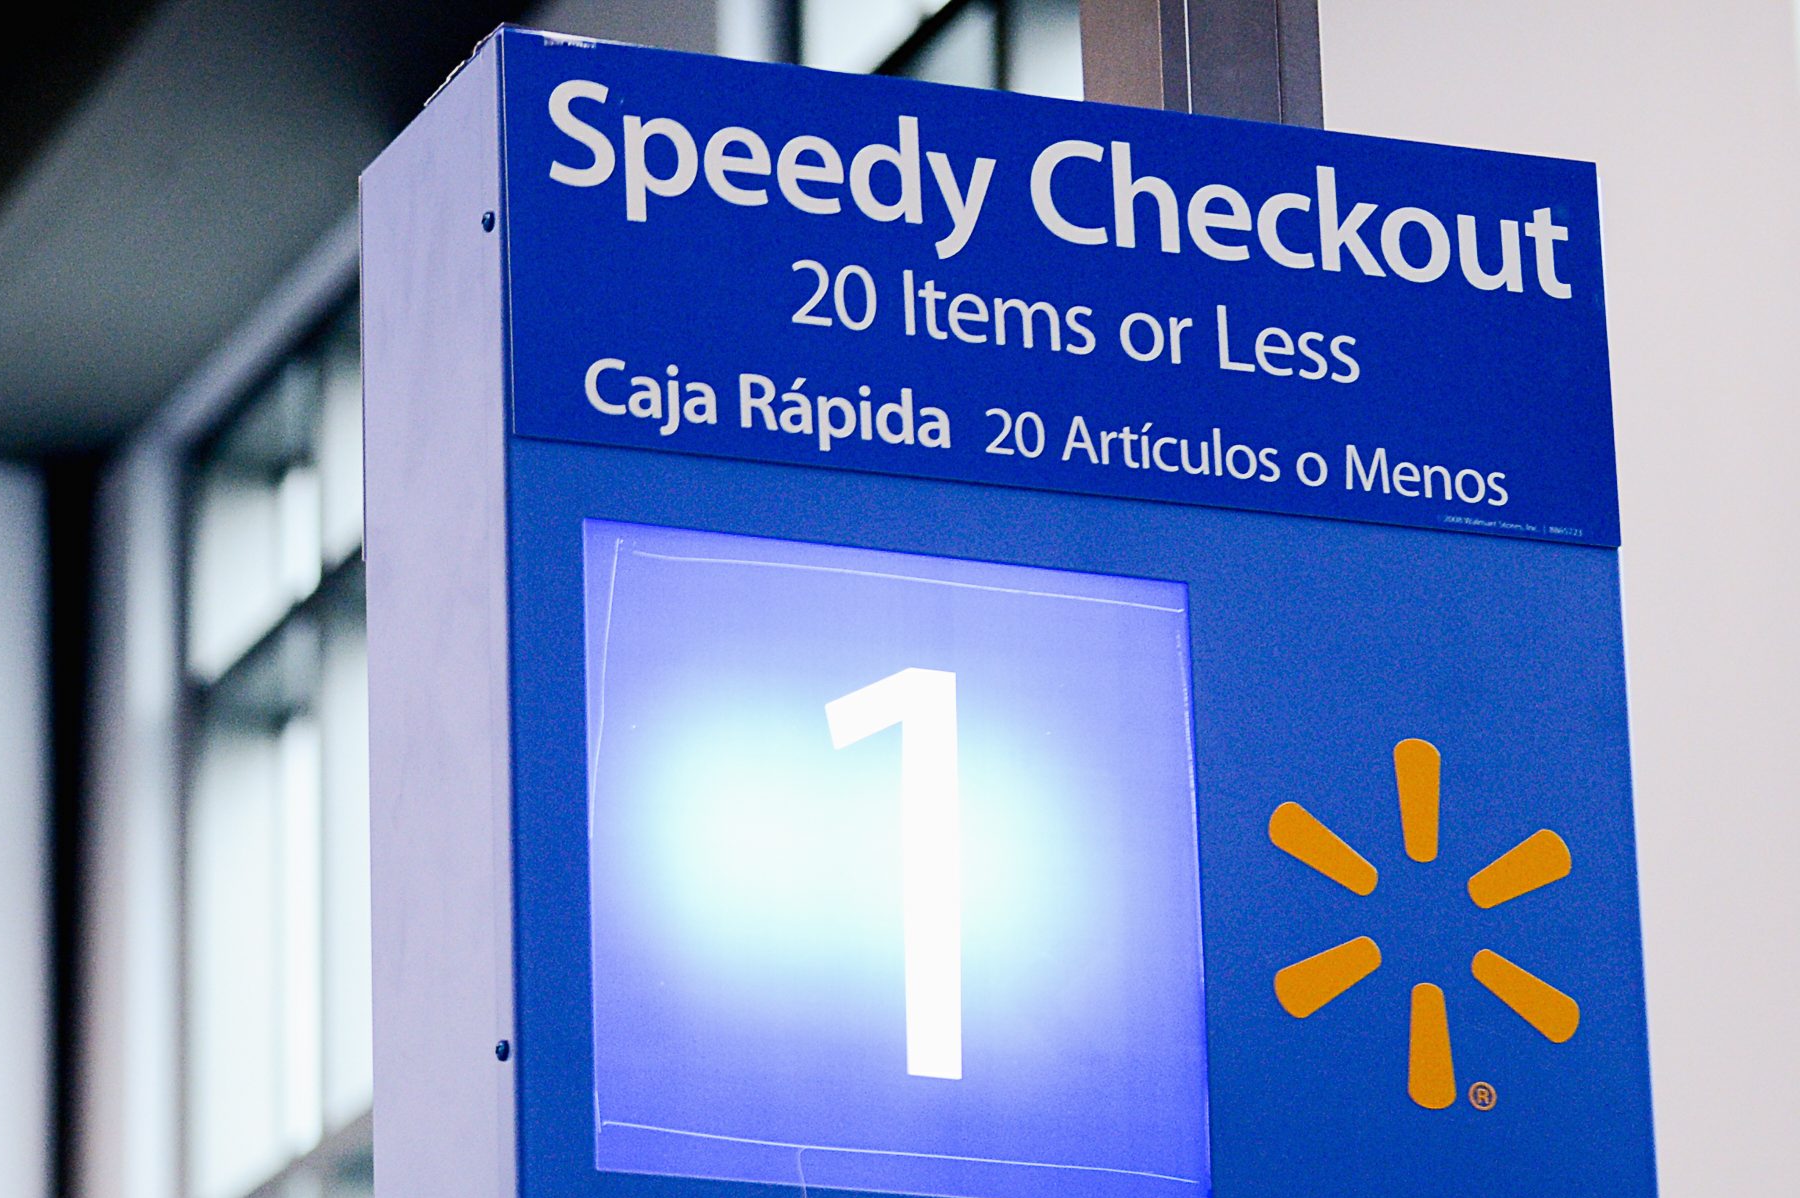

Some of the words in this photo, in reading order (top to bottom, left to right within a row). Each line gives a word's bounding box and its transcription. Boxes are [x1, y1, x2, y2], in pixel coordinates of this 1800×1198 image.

[546, 80, 997, 260] Speedy
[1030, 139, 1573, 300] Checkout
[792, 259, 876, 331] 20
[902, 270, 1096, 354] Items
[1120, 312, 1192, 366] or
[1217, 304, 1361, 384] Less
[585, 358, 718, 436] Caja
[740, 364, 951, 451] Rápida
[985, 408, 1045, 458] 20
[1063, 420, 1280, 485] Artículos
[1297, 454, 1328, 488] o
[1346, 446, 1509, 507] Menos
[825, 667, 962, 1079] 1
